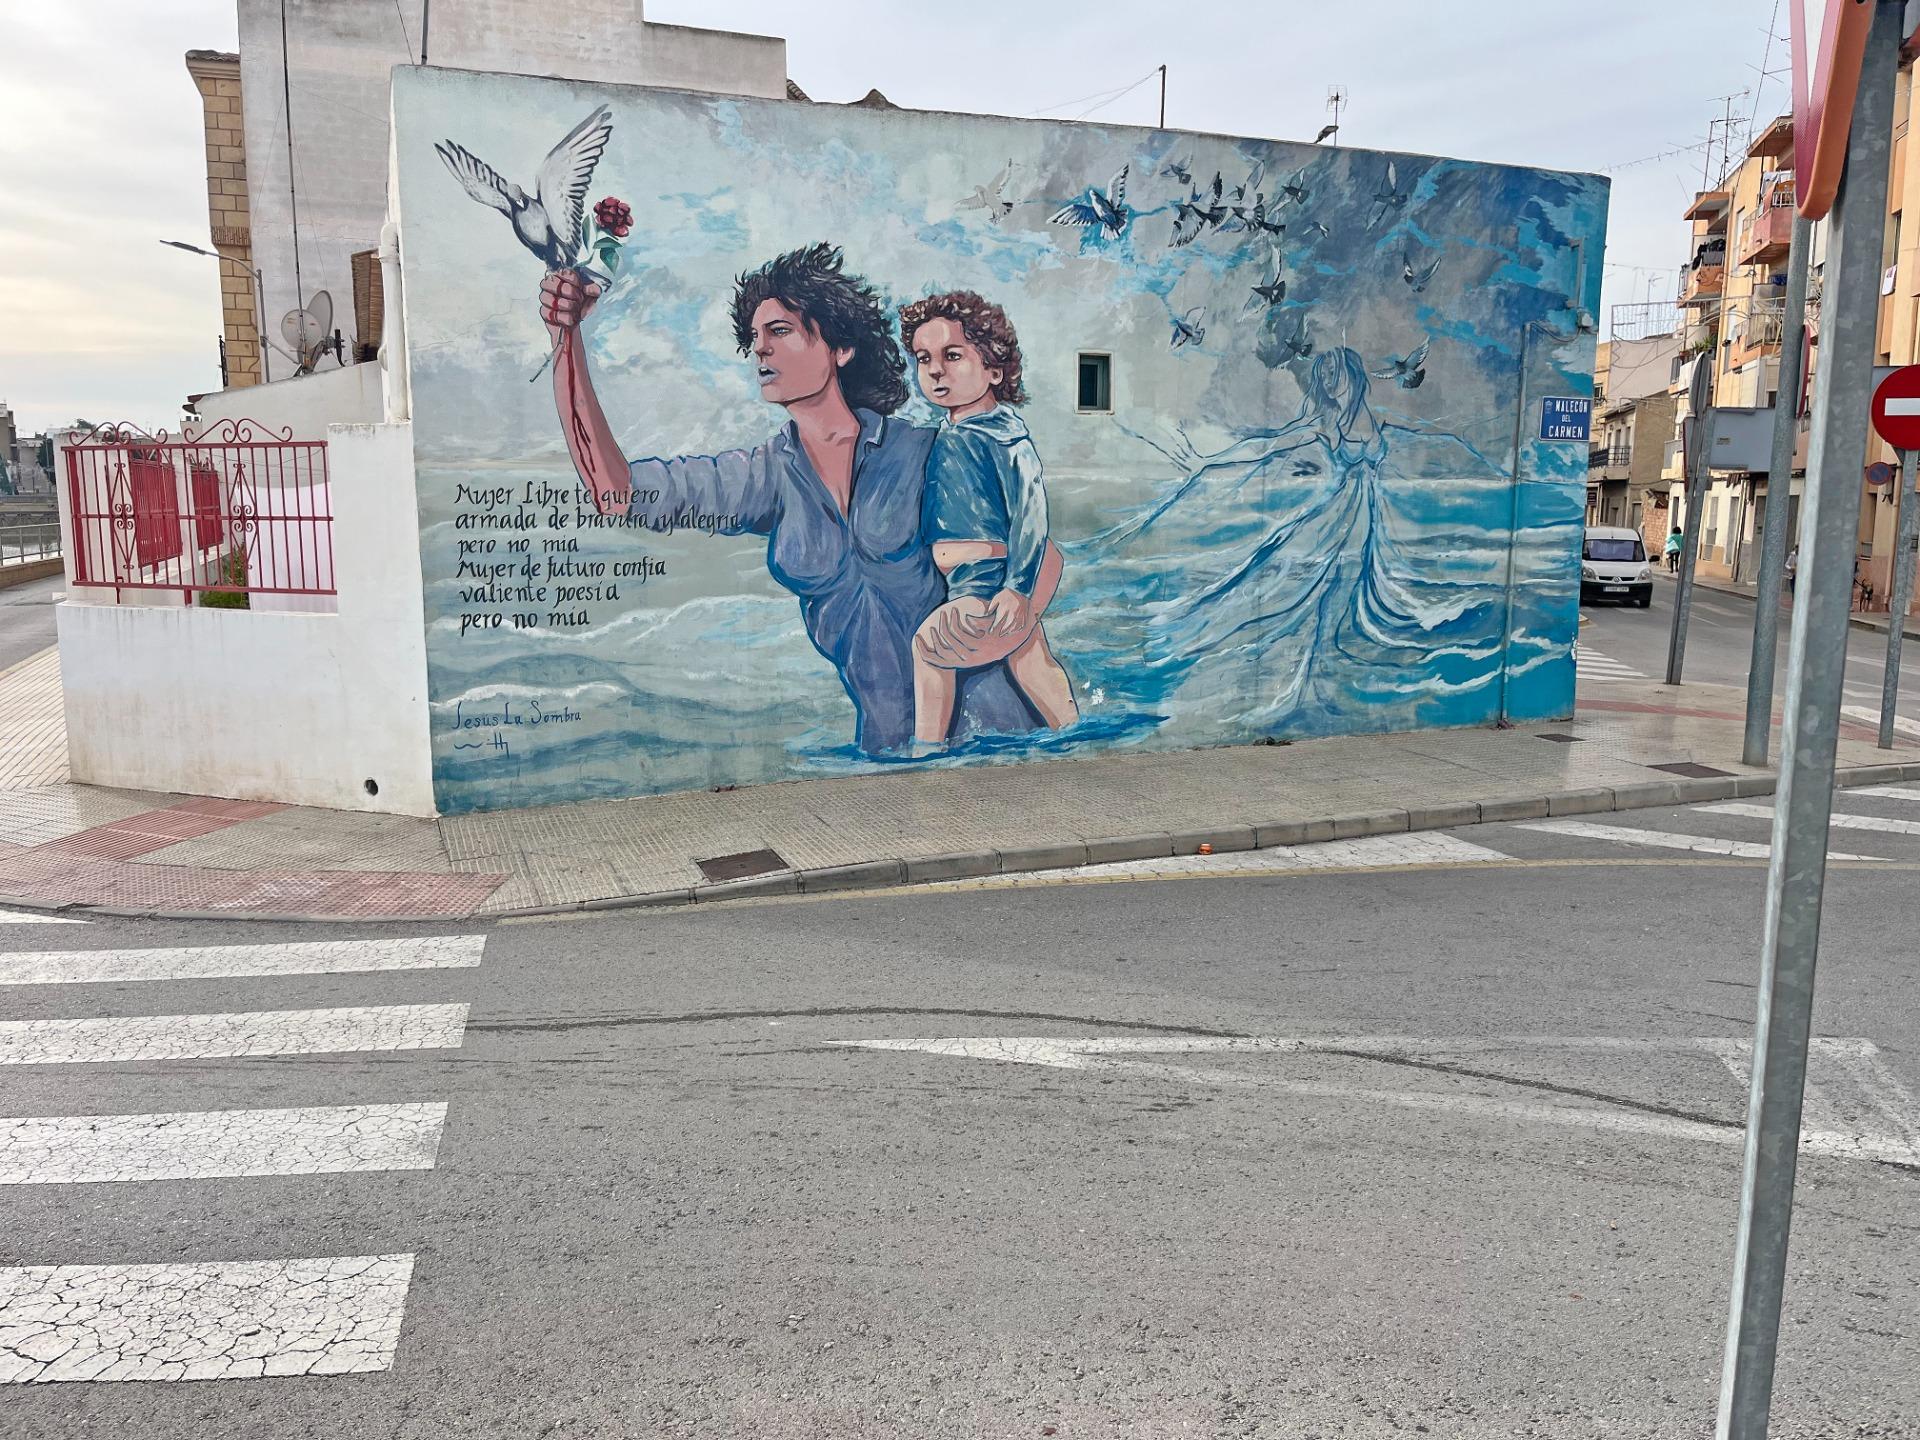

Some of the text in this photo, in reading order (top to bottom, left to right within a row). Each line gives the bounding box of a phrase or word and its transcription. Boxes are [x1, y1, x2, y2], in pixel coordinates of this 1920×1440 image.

[1561, 414, 1571, 423] DEL
[1548, 425, 1583, 438] CARMEN
[454, 483, 514, 512] Mujer
[574, 482, 592, 505] te
[601, 488, 660, 512] quiero
[455, 504, 538, 532] armada
[549, 505, 570, 531] de
[575, 505, 651, 529] bravura
[660, 514, 674, 537] y
[457, 538, 497, 561] pero
[507, 538, 530, 553] no
[456, 560, 516, 585] Mujer
[520, 554, 542, 581] de
[546, 555, 606, 583] futuro
[459, 579, 547, 603] valiente
[460, 612, 503, 637] pero
[512, 612, 538, 629] no
[503, 702, 524, 725] La
[531, 700, 582, 724] Sombra
